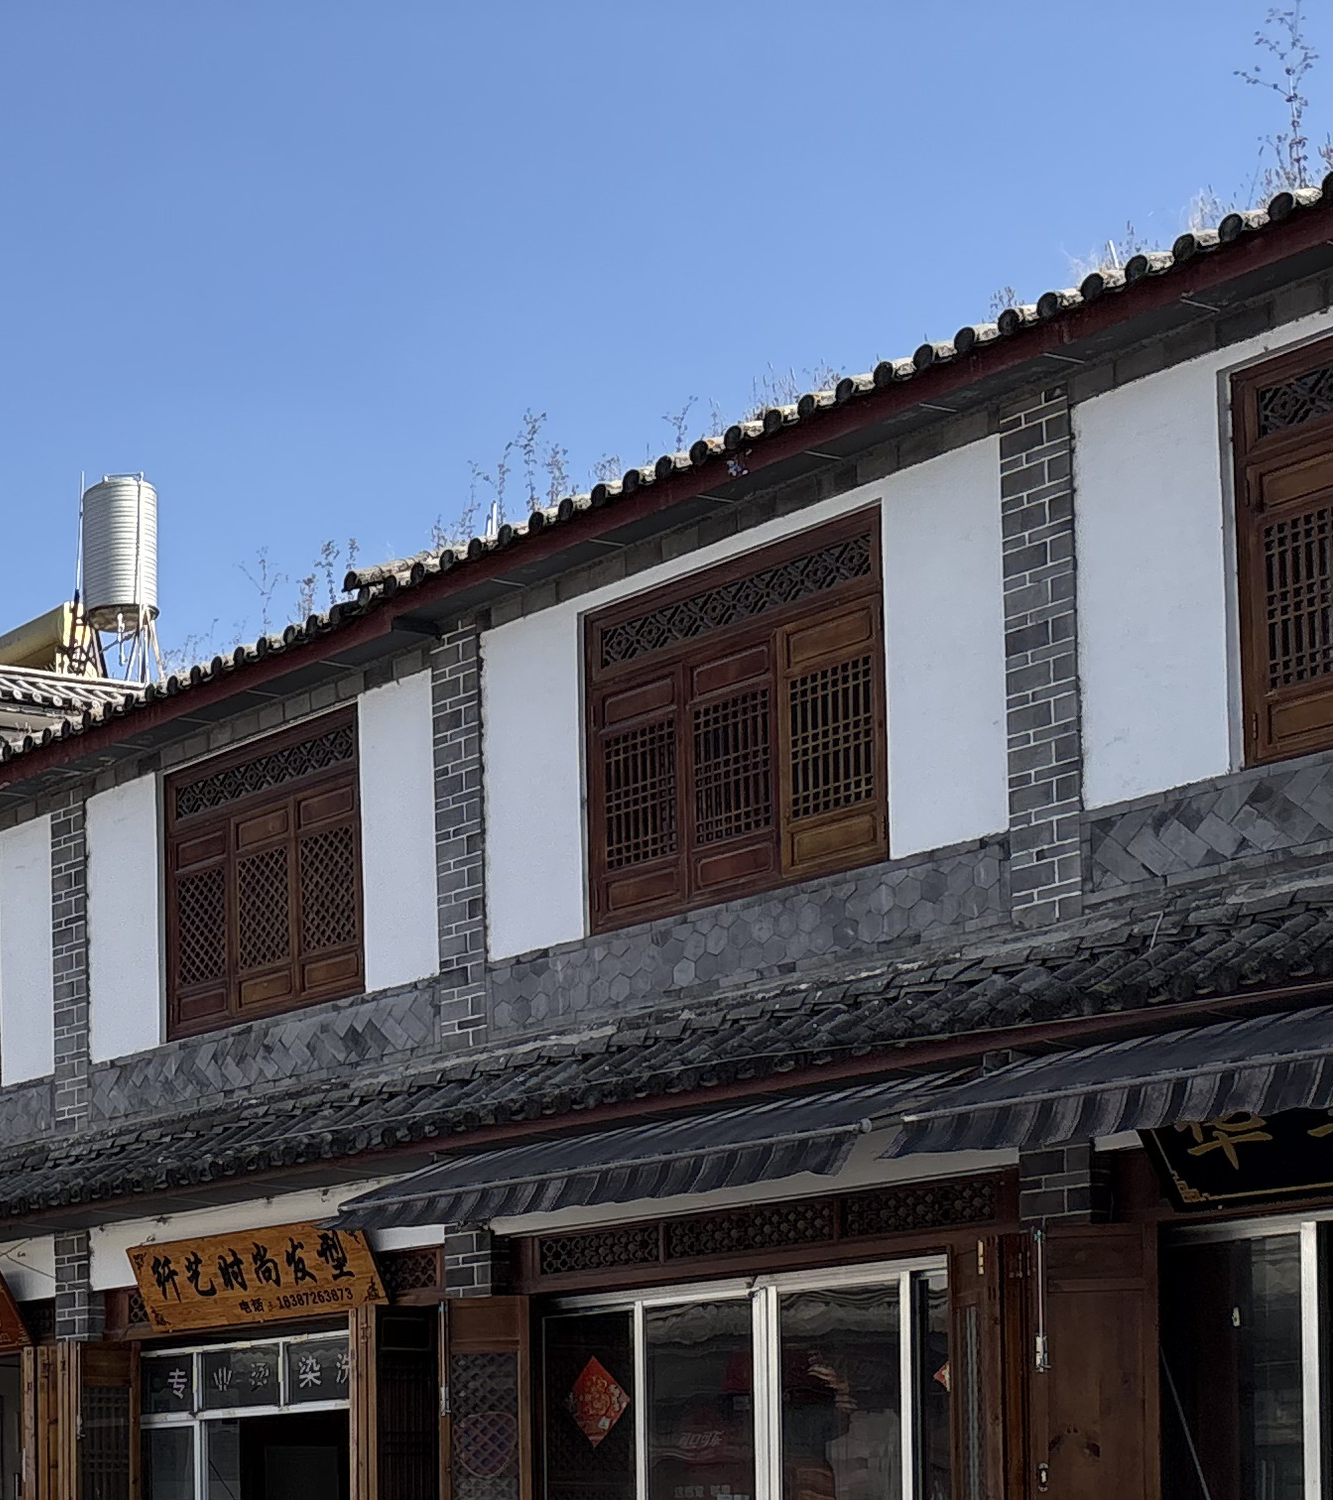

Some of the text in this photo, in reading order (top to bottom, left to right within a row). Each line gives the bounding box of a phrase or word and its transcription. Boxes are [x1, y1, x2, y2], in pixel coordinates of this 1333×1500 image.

[150, 1232, 356, 1303] 纤艺时尚发型
